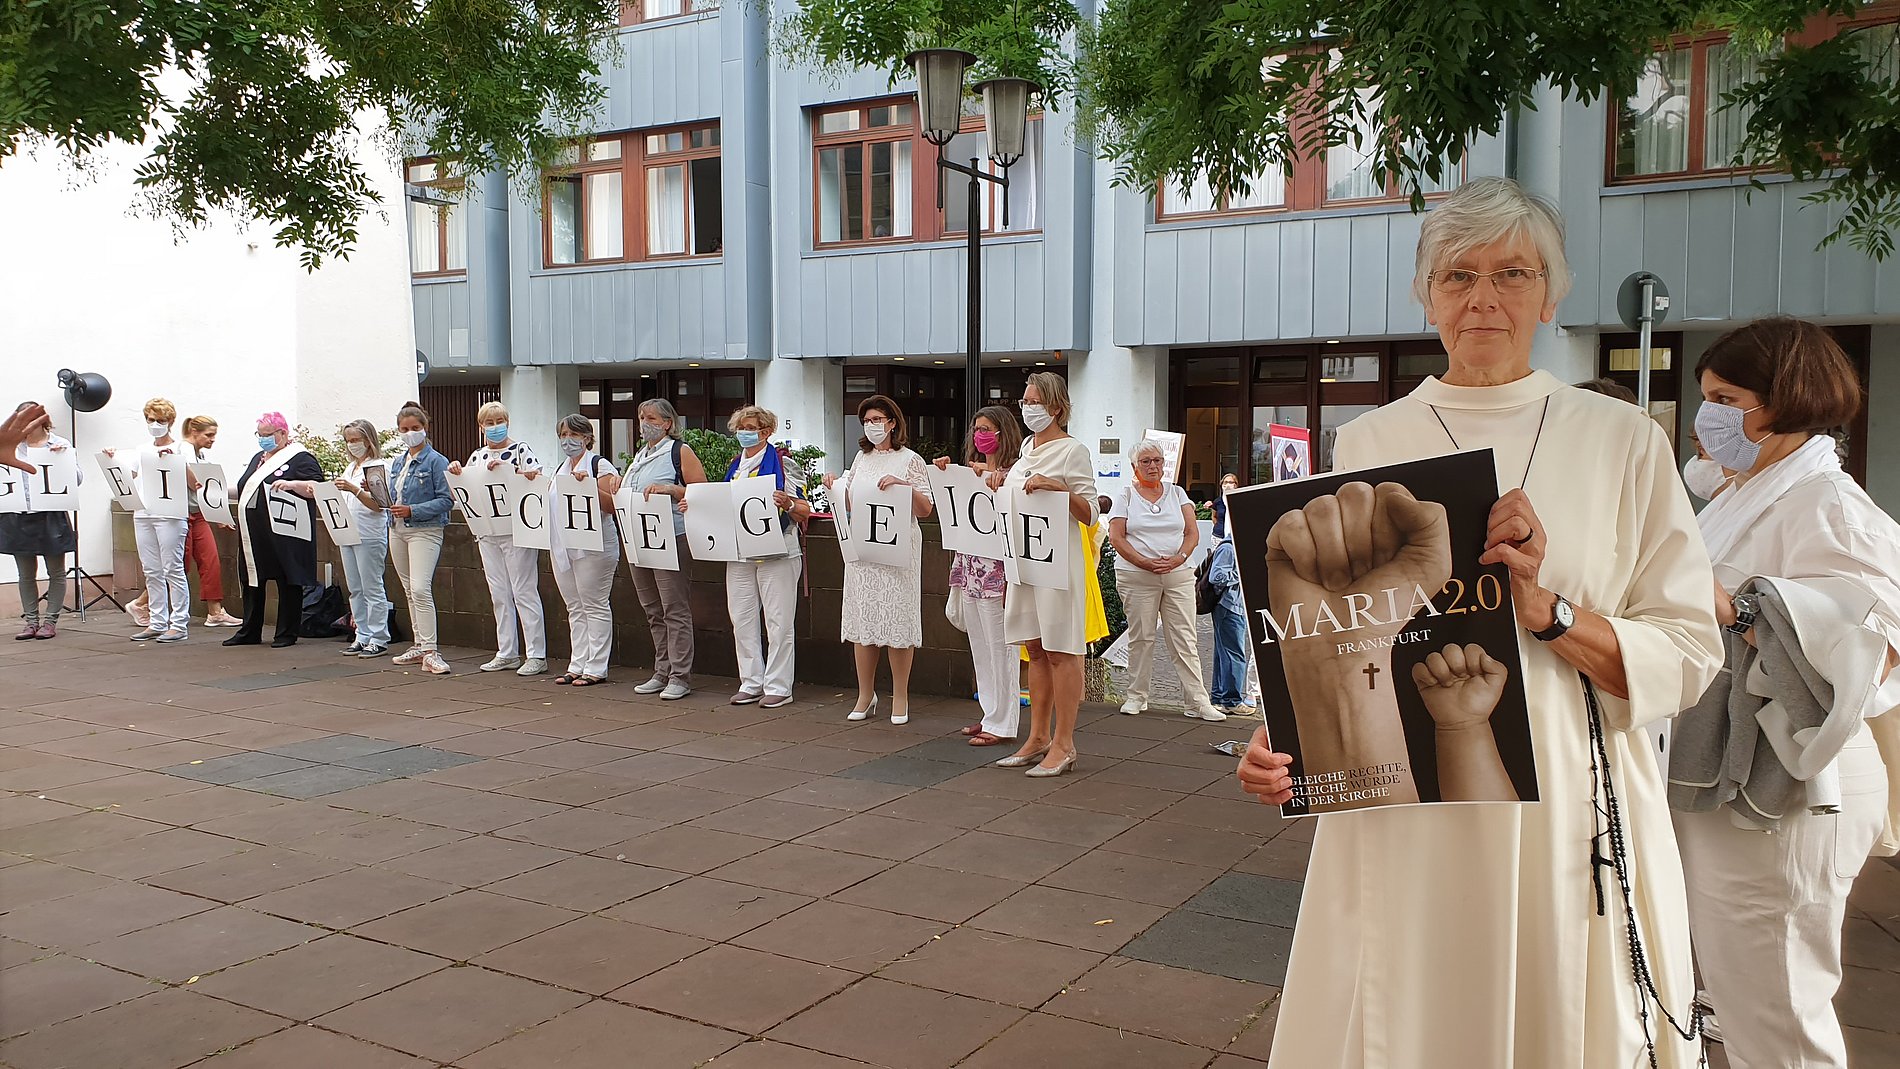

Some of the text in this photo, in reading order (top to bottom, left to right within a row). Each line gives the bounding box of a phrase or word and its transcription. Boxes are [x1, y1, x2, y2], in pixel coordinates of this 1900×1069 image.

[786, 419, 791, 430] 5
[1106, 415, 1113, 427] 5
[38, 464, 68, 495] L
[107, 466, 132, 497] E
[157, 469, 172, 500] I
[203, 477, 223, 510] C
[323, 498, 348, 530] E
[519, 492, 543, 530] C
[562, 493, 598, 532] H
[739, 496, 773, 537] G
[943, 485, 959, 527] I
[967, 491, 998, 535] C
[637, 512, 666, 551] E
[864, 502, 898, 546] E
[1018, 512, 1054, 563] E
[1255, 574, 1503, 644] MARIA 2.0
[1336, 628, 1432, 656] FRANKFURT
[1291, 762, 1407, 786] GLEICHE RECHTE,
[1291, 774, 1401, 797] GLEICHE WÜRDE
[1291, 786, 1390, 808] IN DER KIRCHE
